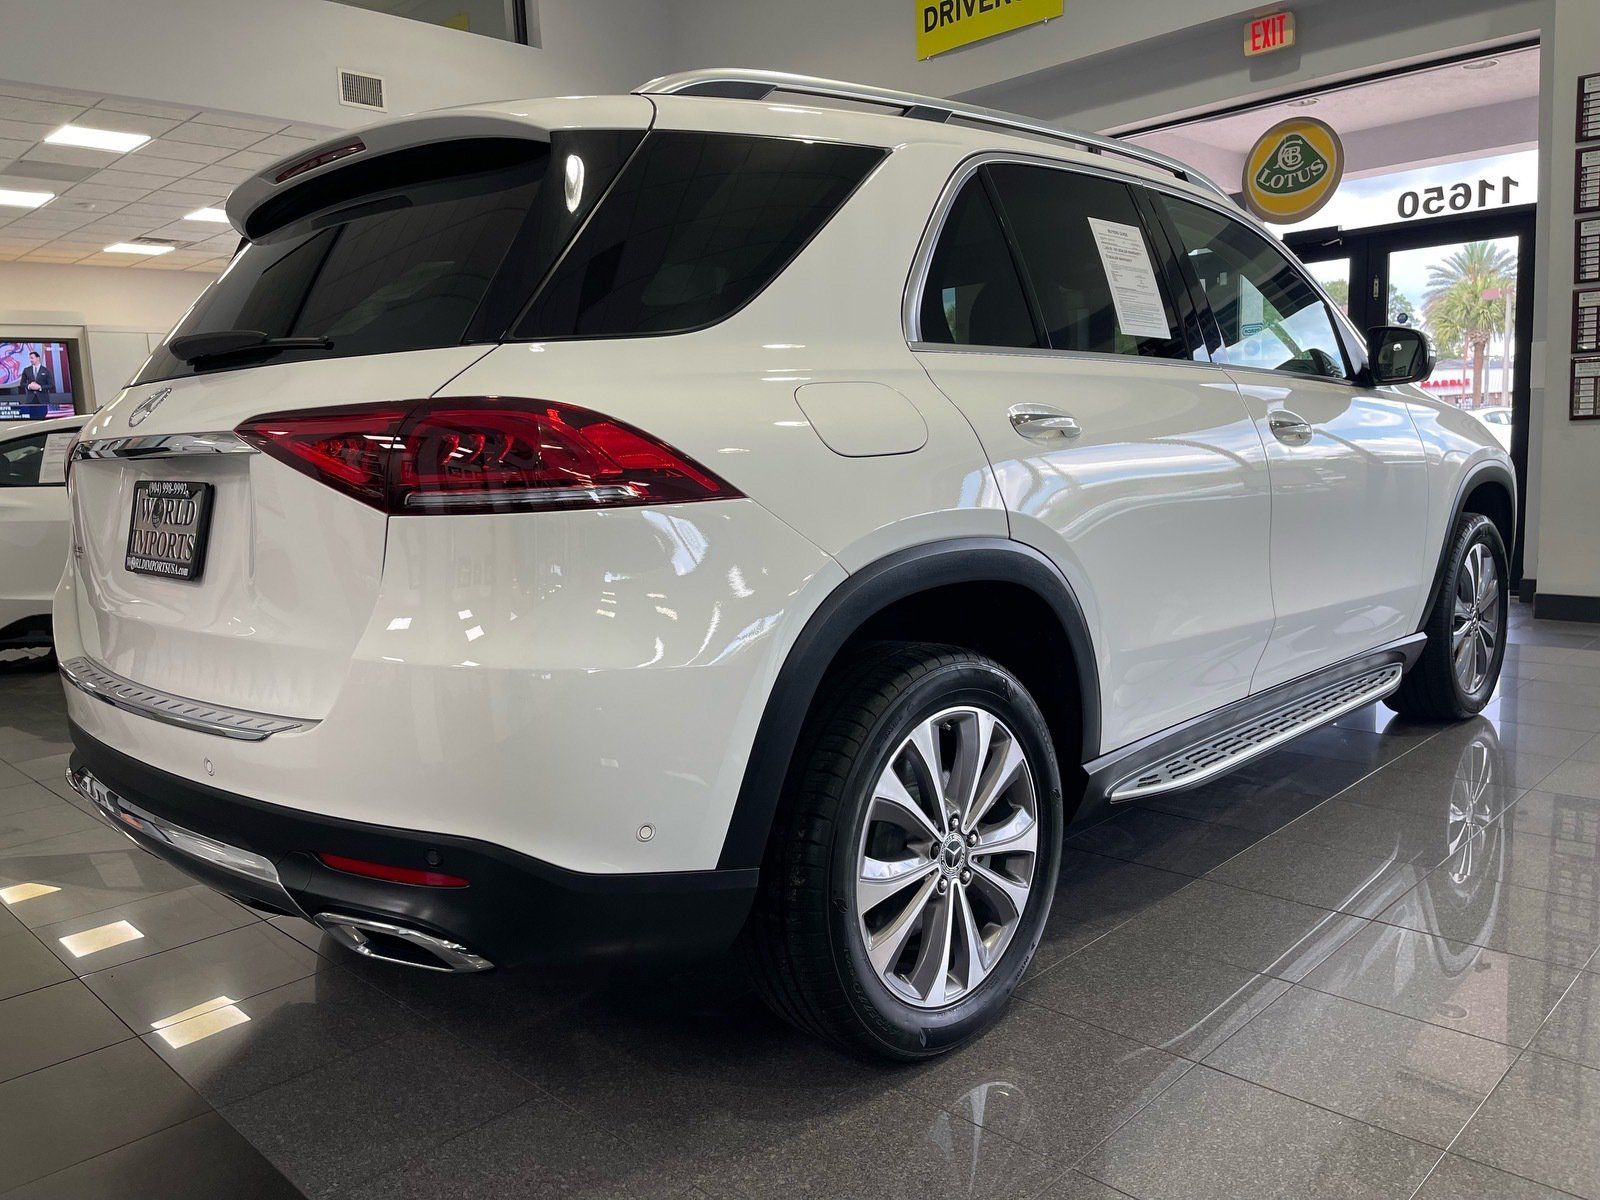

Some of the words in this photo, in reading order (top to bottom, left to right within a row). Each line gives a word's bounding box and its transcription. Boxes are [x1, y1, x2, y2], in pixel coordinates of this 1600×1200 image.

[1251, 14, 1286, 51] EXIT
[1258, 158, 1324, 189] LOTUS
[142, 497, 197, 528] WORLD
[132, 529, 196, 561] IMPORTS
